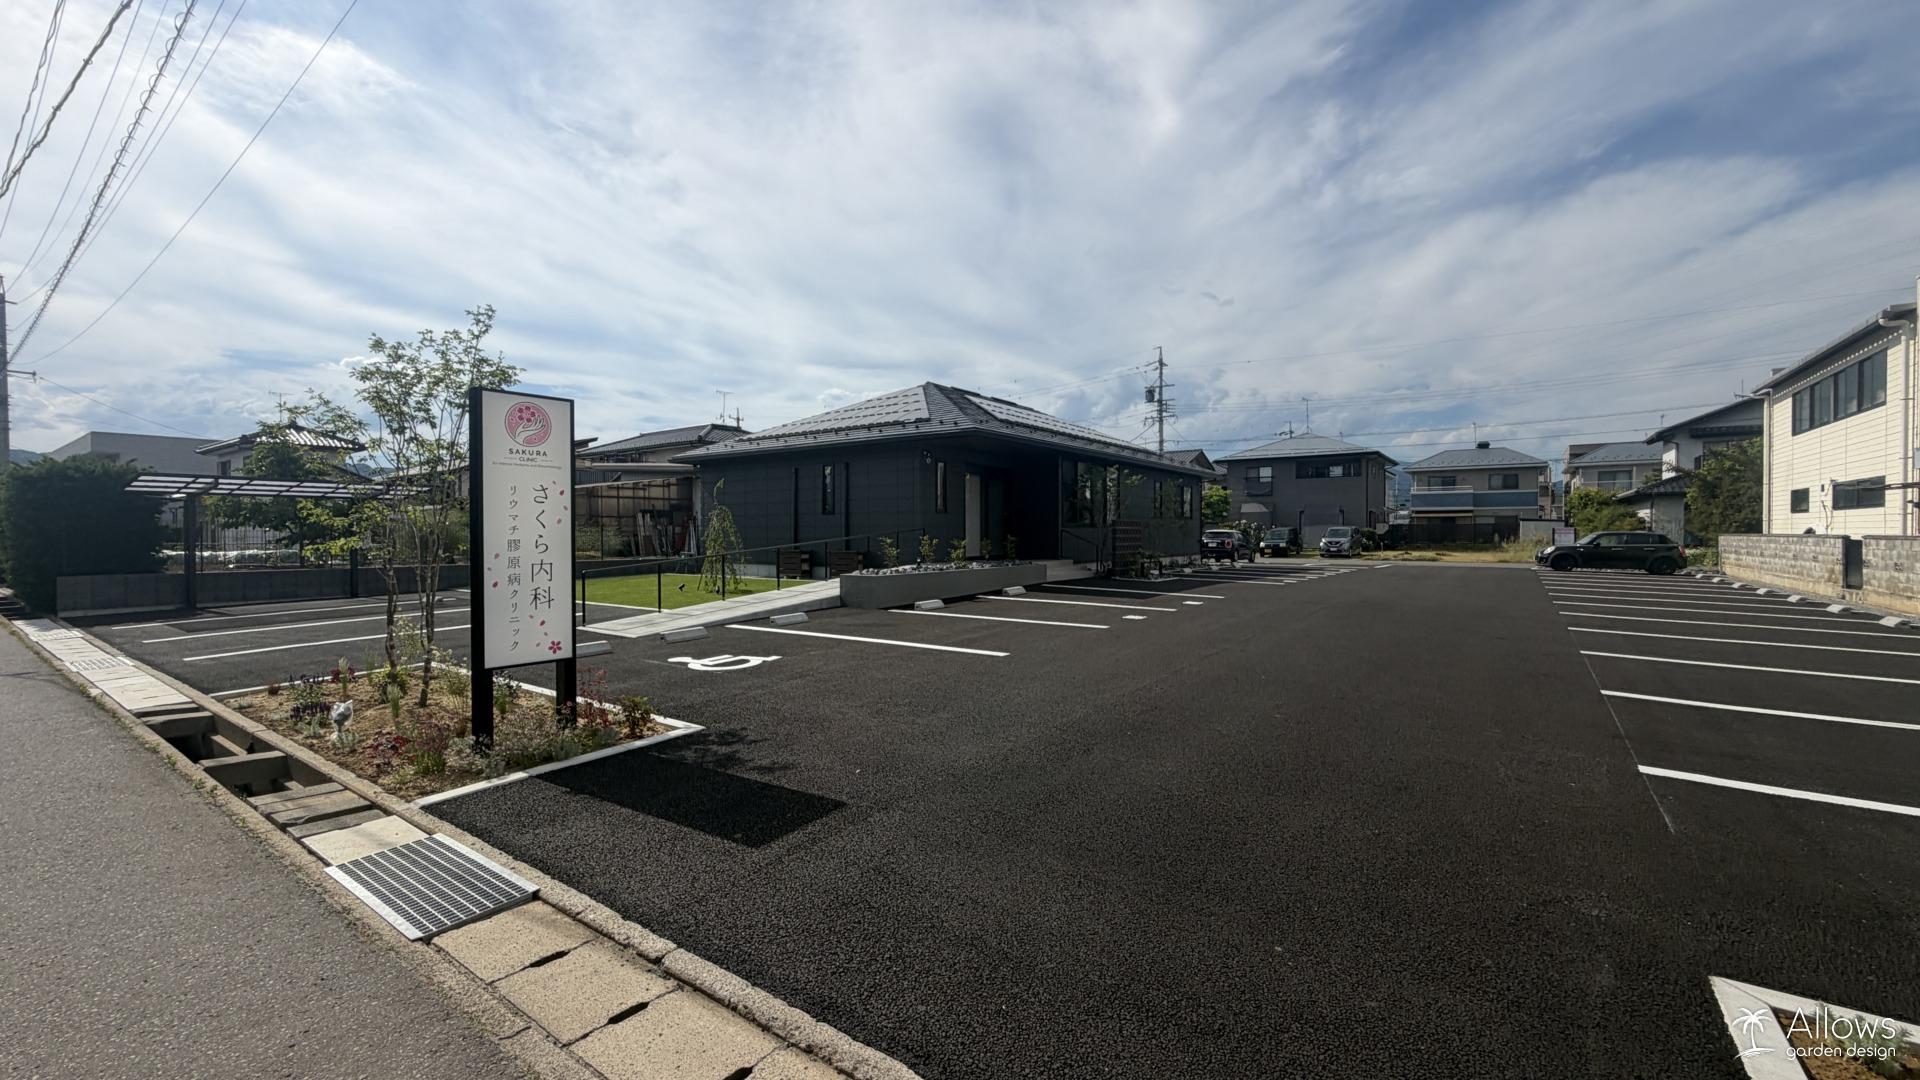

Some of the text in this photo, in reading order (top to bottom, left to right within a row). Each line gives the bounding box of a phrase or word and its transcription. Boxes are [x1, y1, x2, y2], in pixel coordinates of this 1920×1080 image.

[508, 448, 548, 457] SAKURA
[506, 485, 521, 652] リウマチ膠原病クリニック
[529, 484, 555, 611] さくら内科
